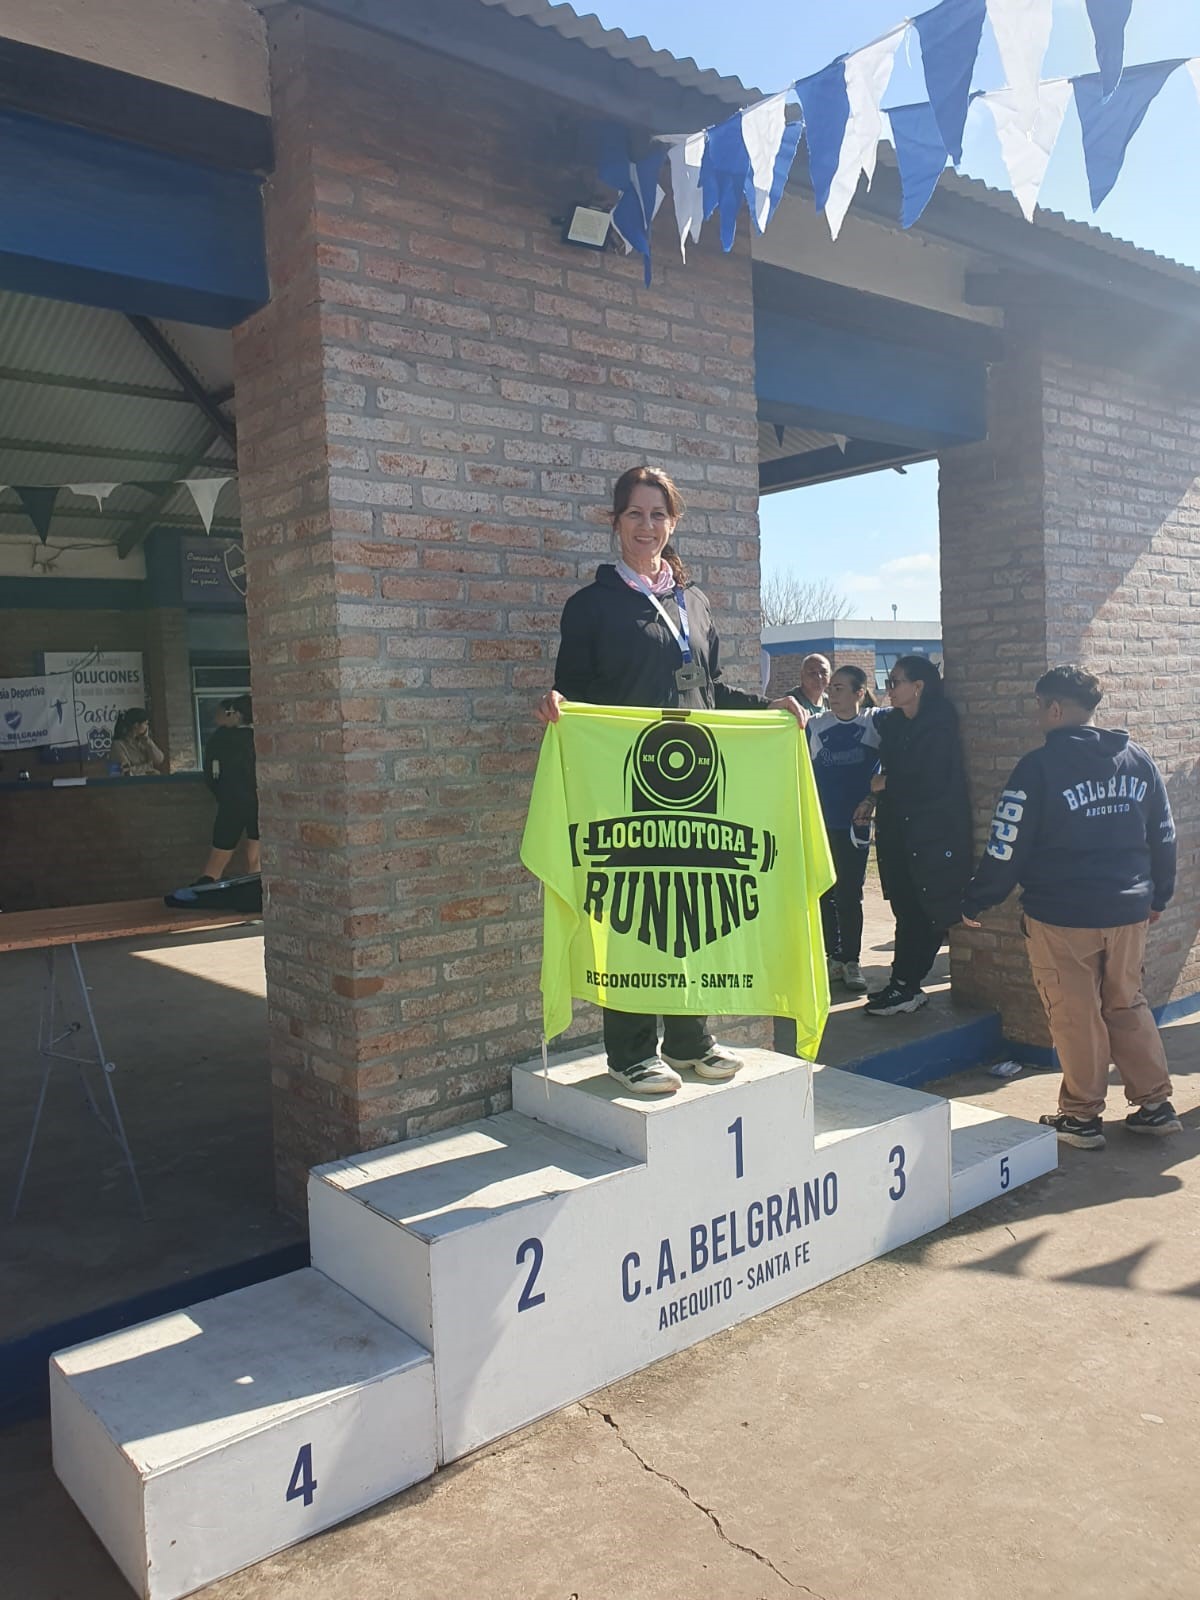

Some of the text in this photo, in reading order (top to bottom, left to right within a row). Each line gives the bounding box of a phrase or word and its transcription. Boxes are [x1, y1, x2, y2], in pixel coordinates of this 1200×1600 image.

[11, 686, 45, 701] Deportiva
[74, 700, 124, 724] Pasió
[642, 753, 711, 766] KM KM
[1063, 774, 1148, 811] BELGRANO
[597, 819, 746, 852] LOCOMOTORA
[986, 789, 1028, 861] 1923
[584, 871, 759, 958] RUNNING
[586, 970, 687, 989] RECONQUISTA
[727, 1116, 744, 1179] 1
[888, 1145, 906, 1201] 3
[1000, 1156, 1010, 1189] 5
[515, 1237, 546, 1312] 2
[658, 1276, 733, 1331] AREQUITO
[747, 1258, 792, 1290] SANTA
[795, 1241, 811, 1266] FE
[286, 1442, 317, 1507] 4
